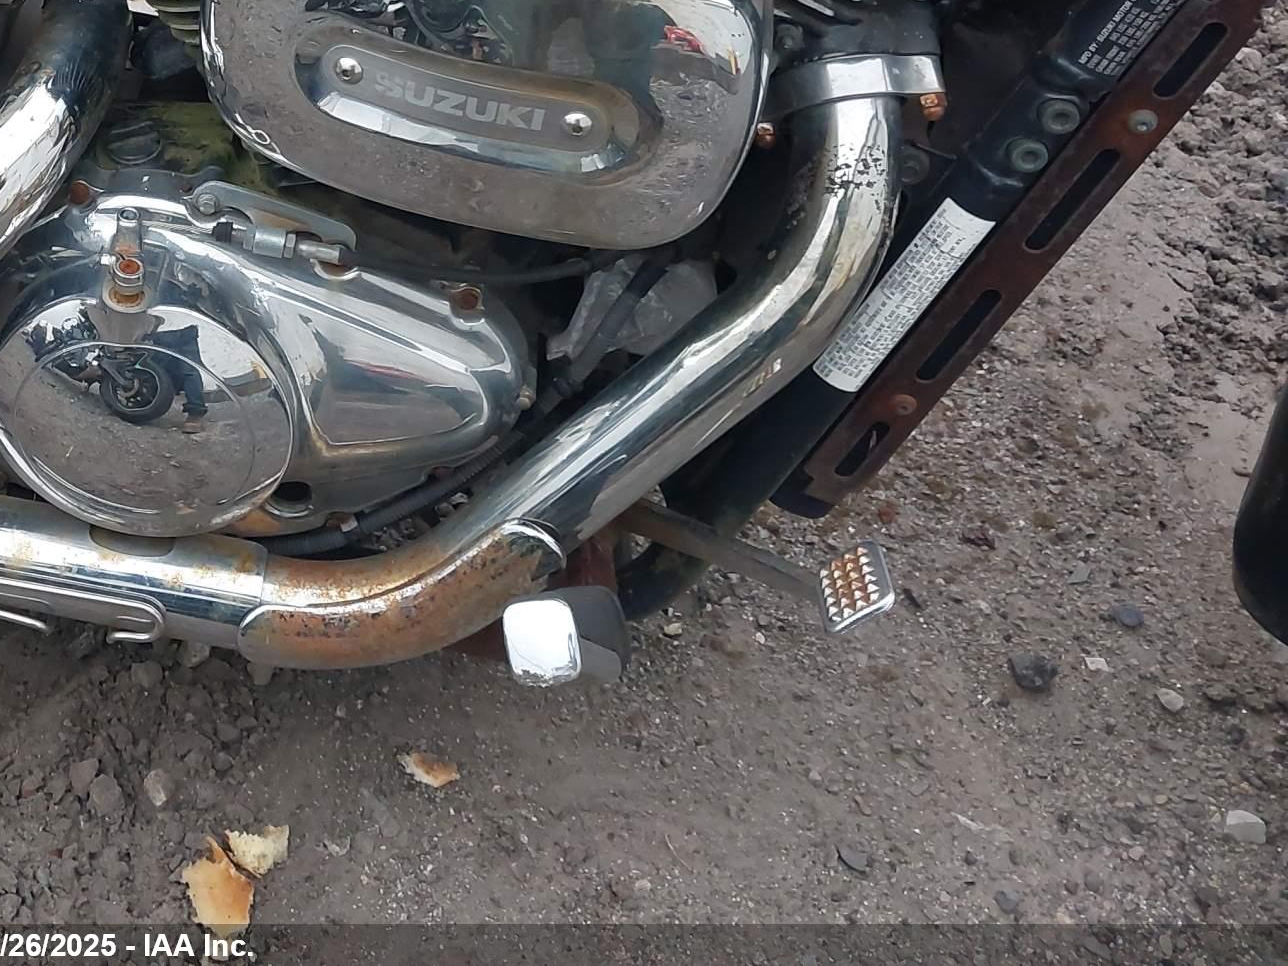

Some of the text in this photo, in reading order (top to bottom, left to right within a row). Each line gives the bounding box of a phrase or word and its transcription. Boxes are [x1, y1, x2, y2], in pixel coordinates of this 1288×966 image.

[1096, 21, 1116, 42] SUZUKI
[1112, 0, 1133, 22] MOTOR
[373, 70, 547, 131] SUZUKI
